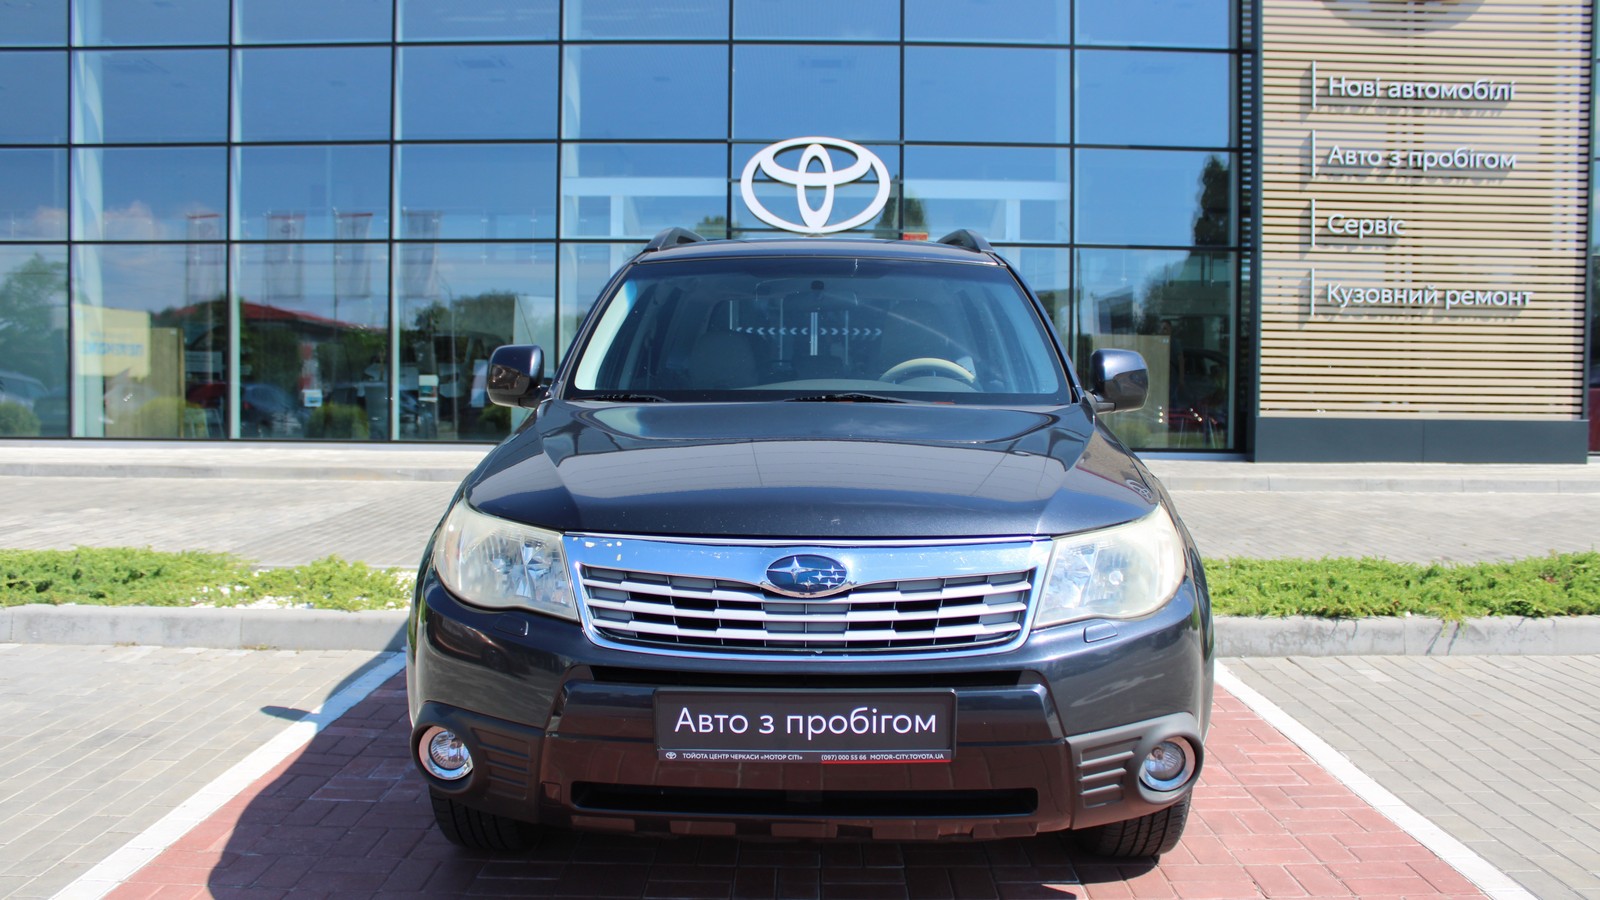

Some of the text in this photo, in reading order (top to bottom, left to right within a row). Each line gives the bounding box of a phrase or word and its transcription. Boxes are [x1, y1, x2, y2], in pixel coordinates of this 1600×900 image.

[1328, 76, 1516, 101] Нові автомобілі
[1327, 145, 1517, 172] Авто з пробігом
[1327, 214, 1406, 239] Сервіс
[1327, 283, 1534, 311] Кузовний ремонт
[674, 707, 936, 741] Авто з пробігом
[682, 752, 708, 760] ТОЙОТА
[709, 753, 729, 761] ЦЕНТР
